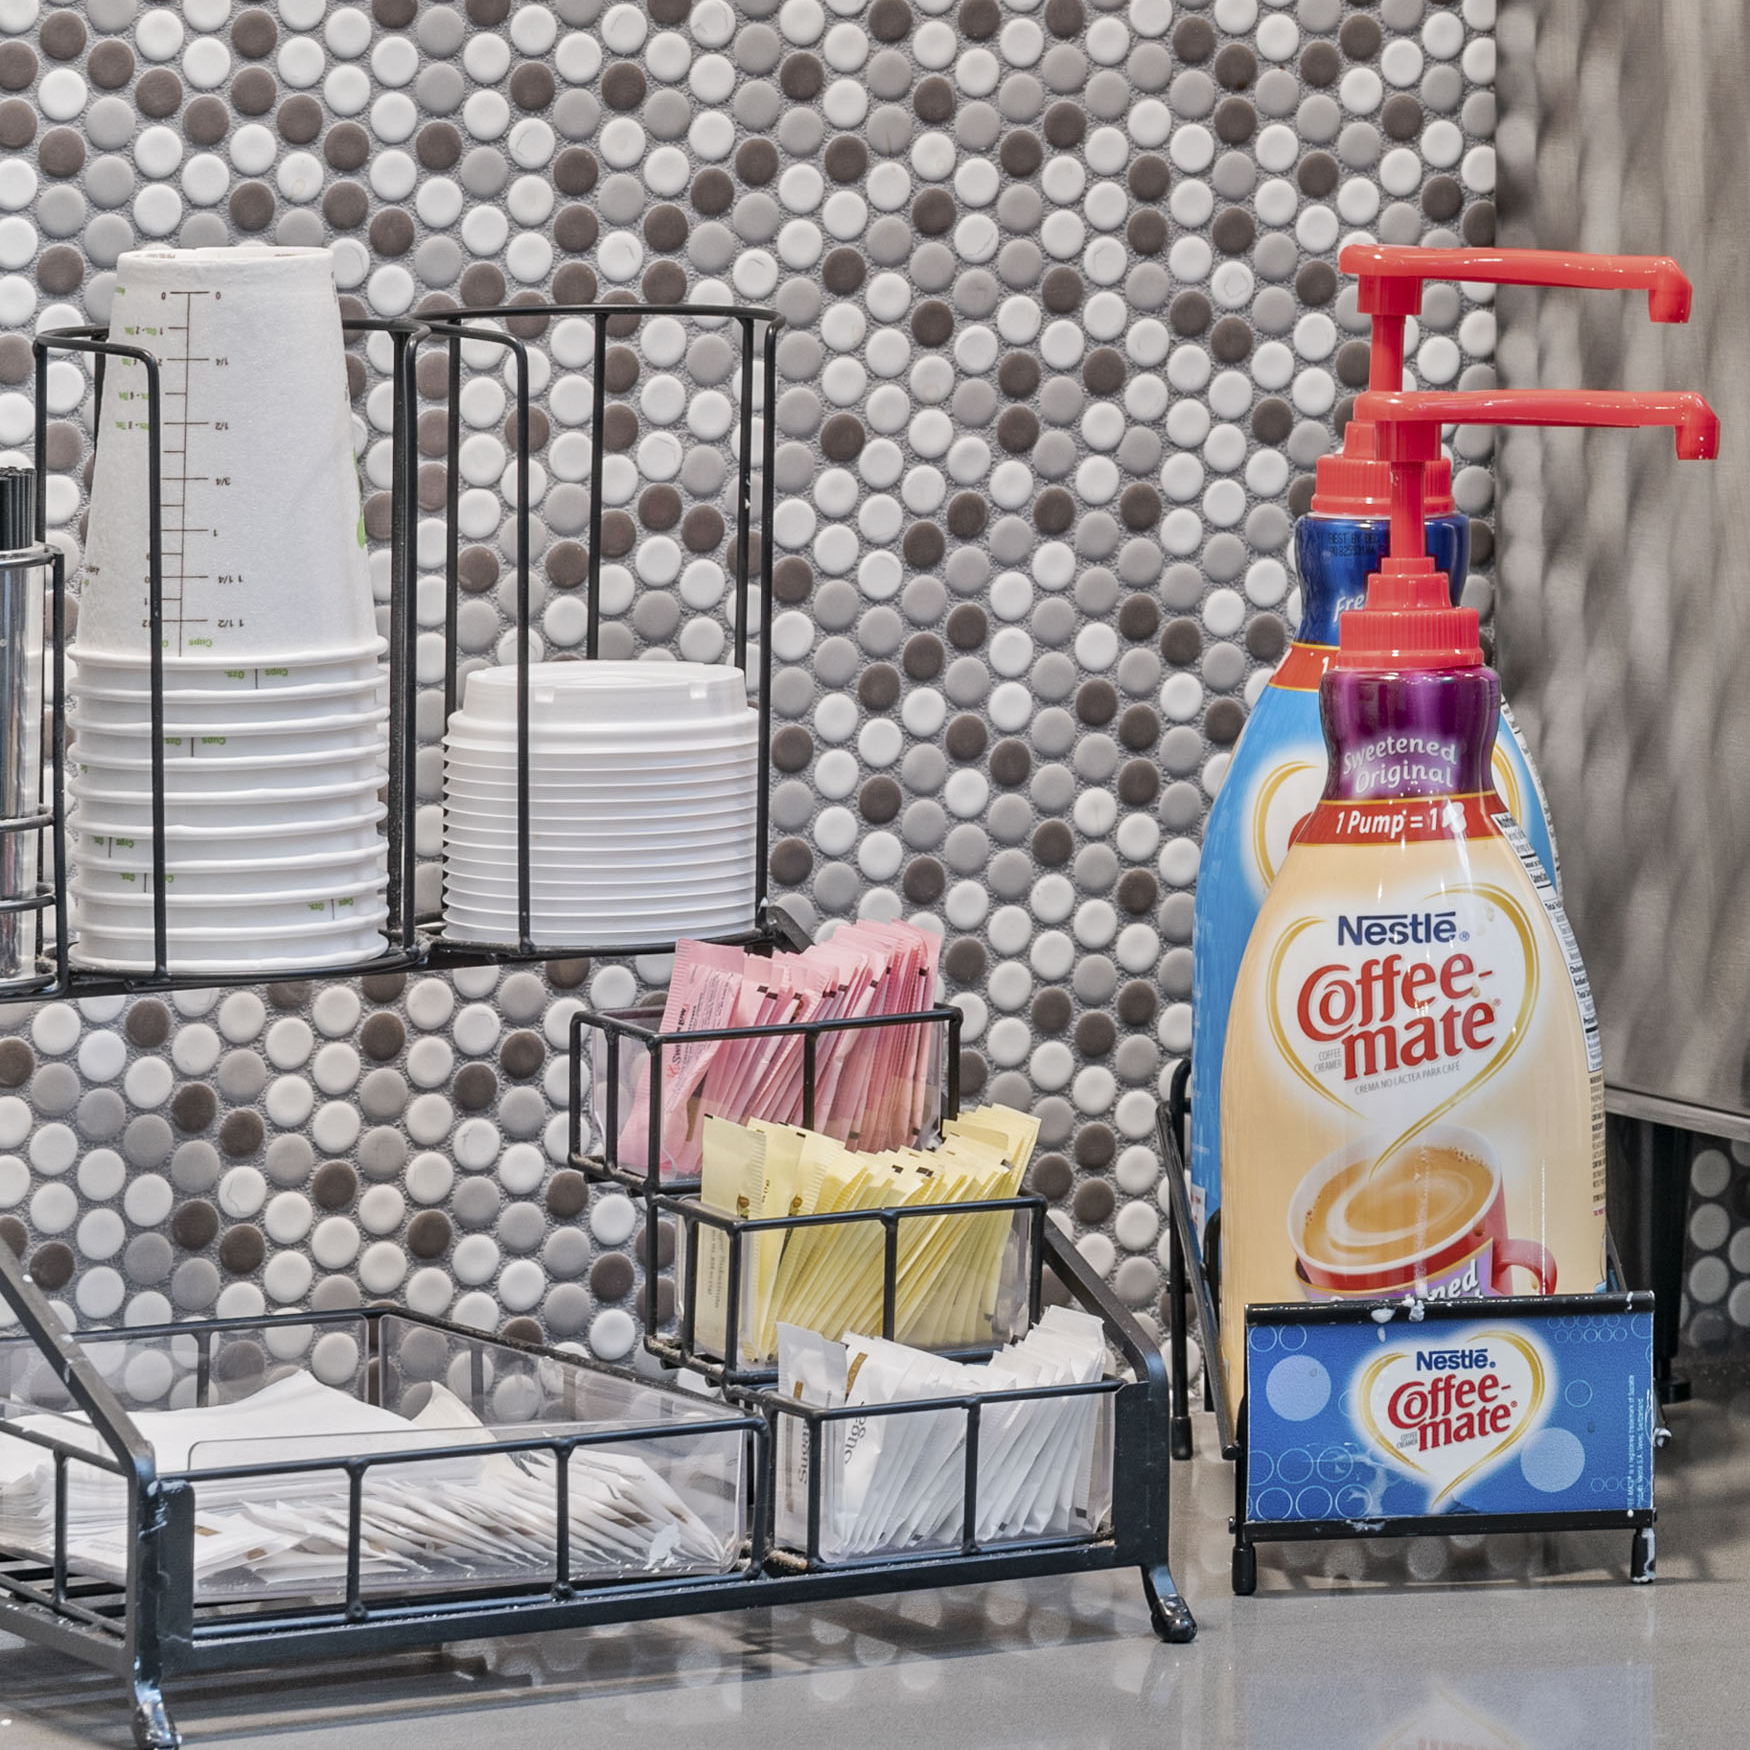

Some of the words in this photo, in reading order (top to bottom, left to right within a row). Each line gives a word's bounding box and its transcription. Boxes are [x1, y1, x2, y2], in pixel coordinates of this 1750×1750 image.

[264, 667, 289, 678] Cups
[201, 736, 227, 746] Cups
[1343, 735, 1457, 776] Sweetened
[1355, 759, 1453, 795] Original
[1335, 811, 1346, 835] 1
[1347, 810, 1405, 840] Pump
[1318, 1047, 1342, 1062] COFFEE
[1313, 1058, 1343, 1075] CREAMER
[1354, 1082, 1381, 1096] CREMA
[1381, 1079, 1394, 1090] NO
[1422, 1068, 1442, 1080] PARA
